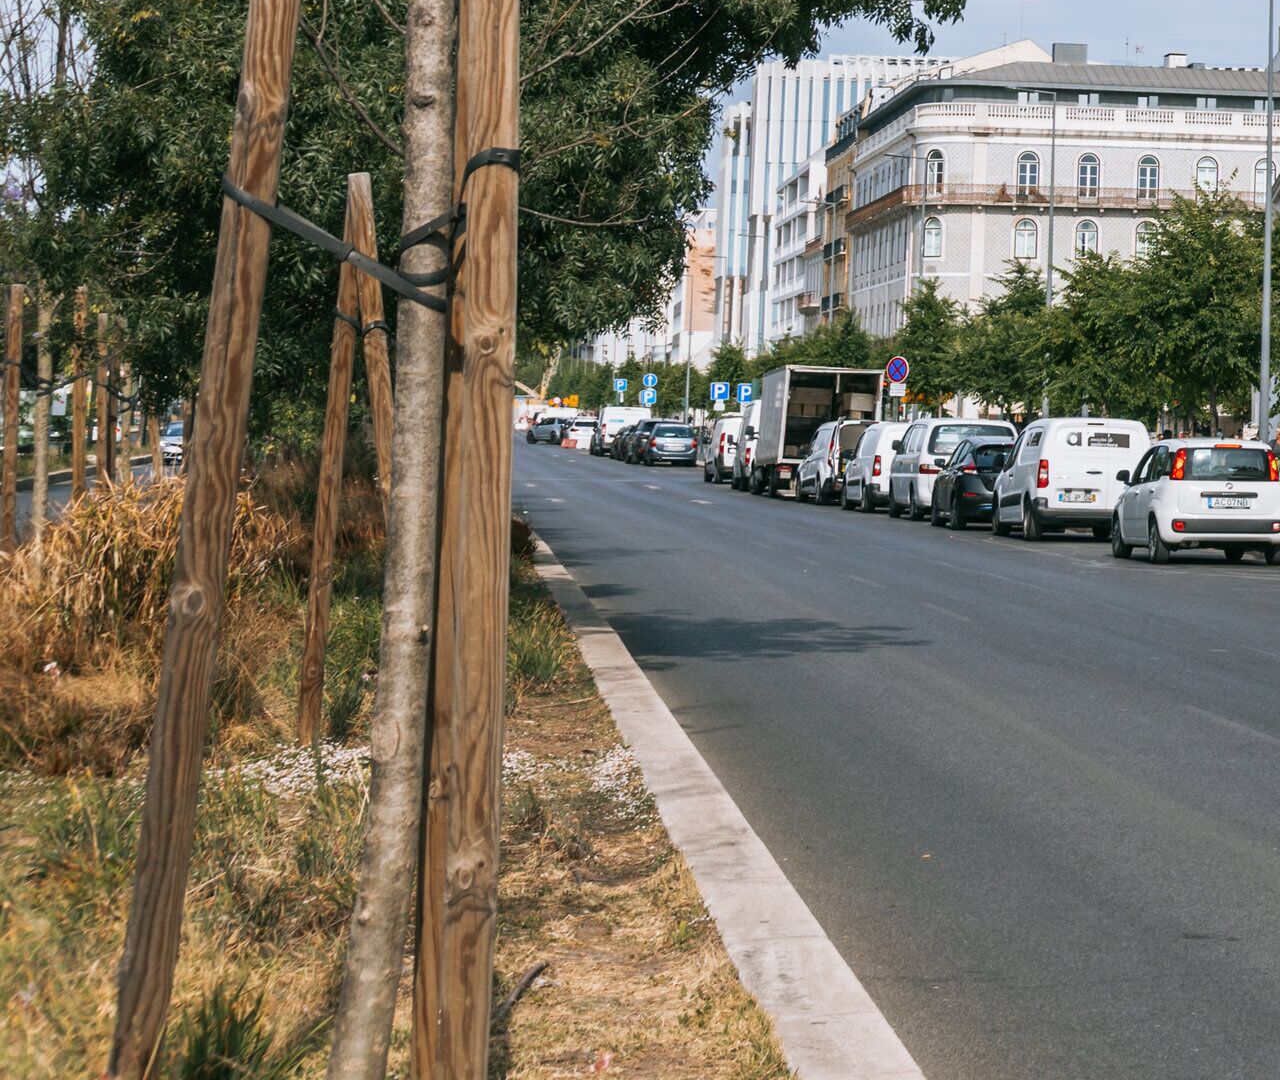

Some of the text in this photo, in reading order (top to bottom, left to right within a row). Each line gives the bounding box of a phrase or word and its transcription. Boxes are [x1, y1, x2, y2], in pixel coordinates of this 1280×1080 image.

[616, 380, 624, 390] P
[714, 383, 726, 399] P
[644, 391, 653, 402] P
[741, 385, 752, 401] P
